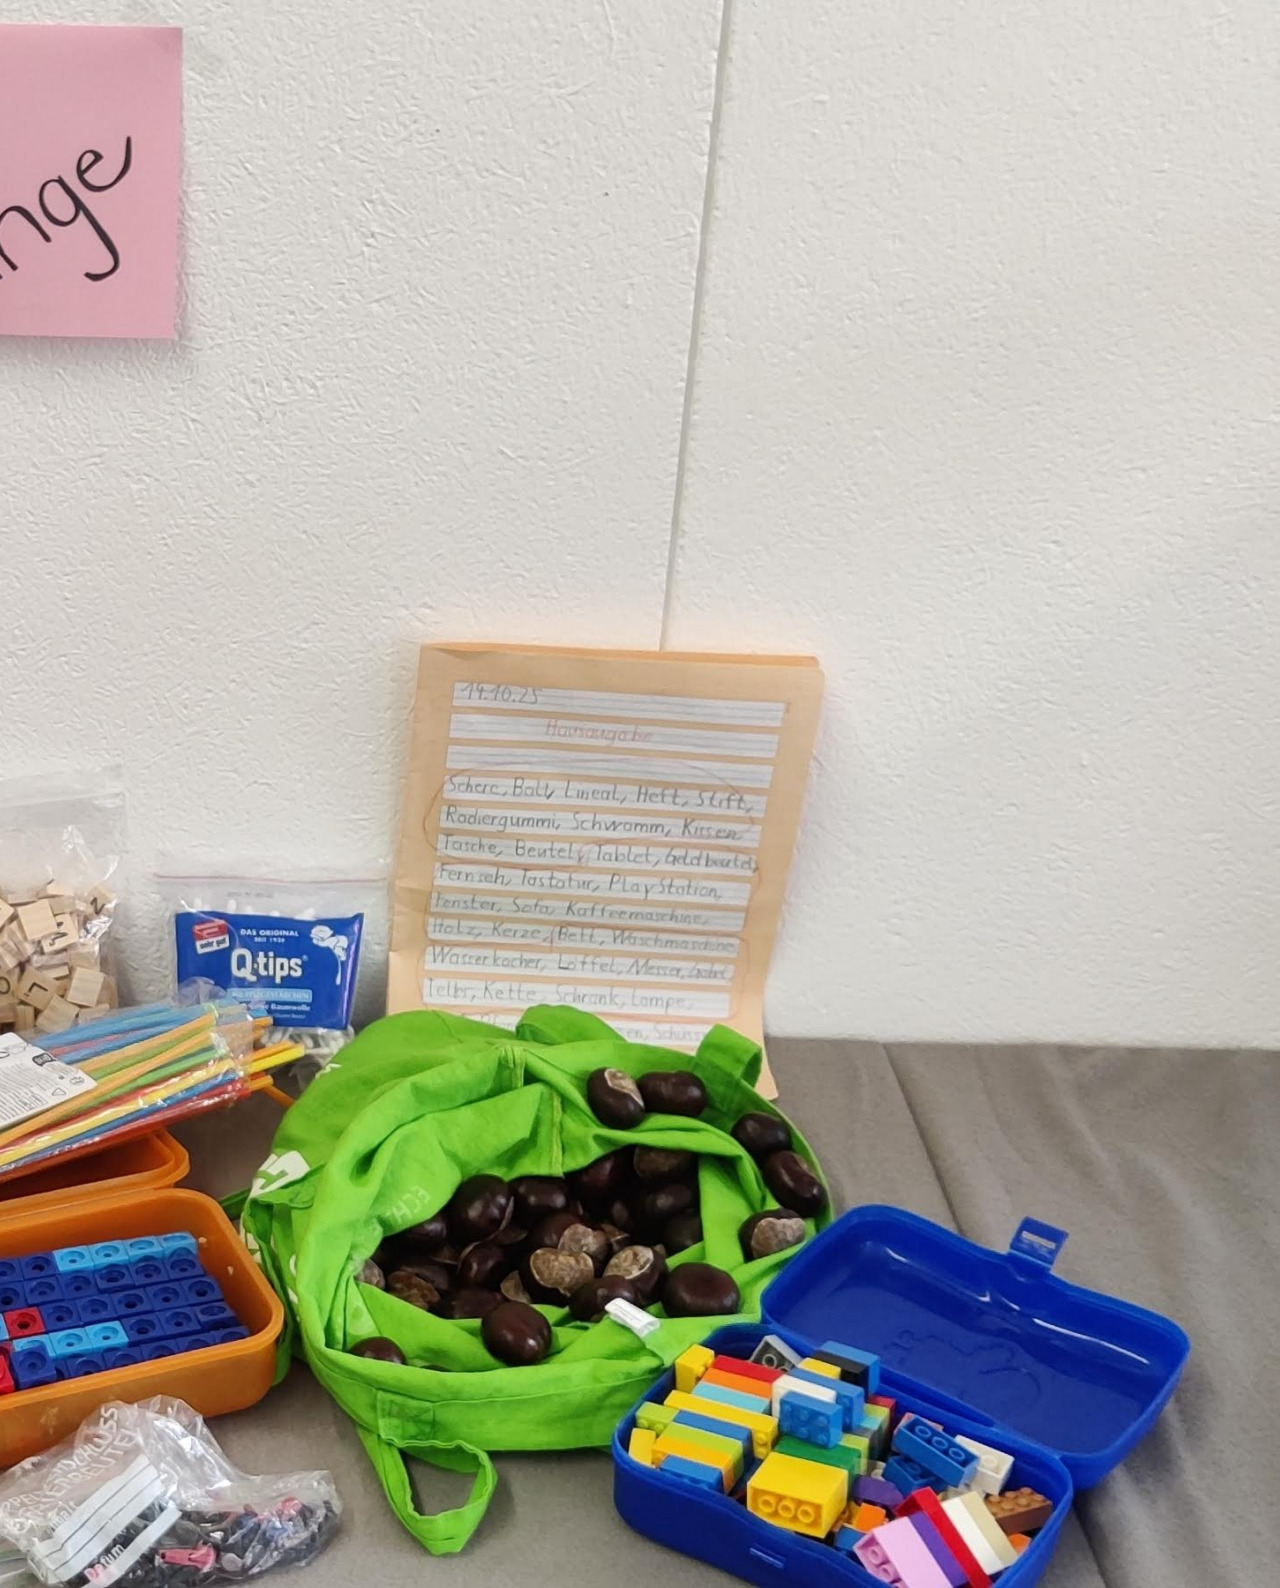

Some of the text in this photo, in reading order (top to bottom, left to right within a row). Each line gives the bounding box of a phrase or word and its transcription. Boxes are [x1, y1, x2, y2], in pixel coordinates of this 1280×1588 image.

[449, 775, 508, 797] Schere,
[565, 779, 627, 805] Lineal,
[636, 785, 688, 808] Heft,
[696, 790, 753, 813] Stift,
[446, 804, 560, 832] Radiergummi,
[571, 811, 672, 837] Schwamm,
[443, 833, 504, 857] Tasche,
[240, 928, 299, 937] DAS ORIGINAL
